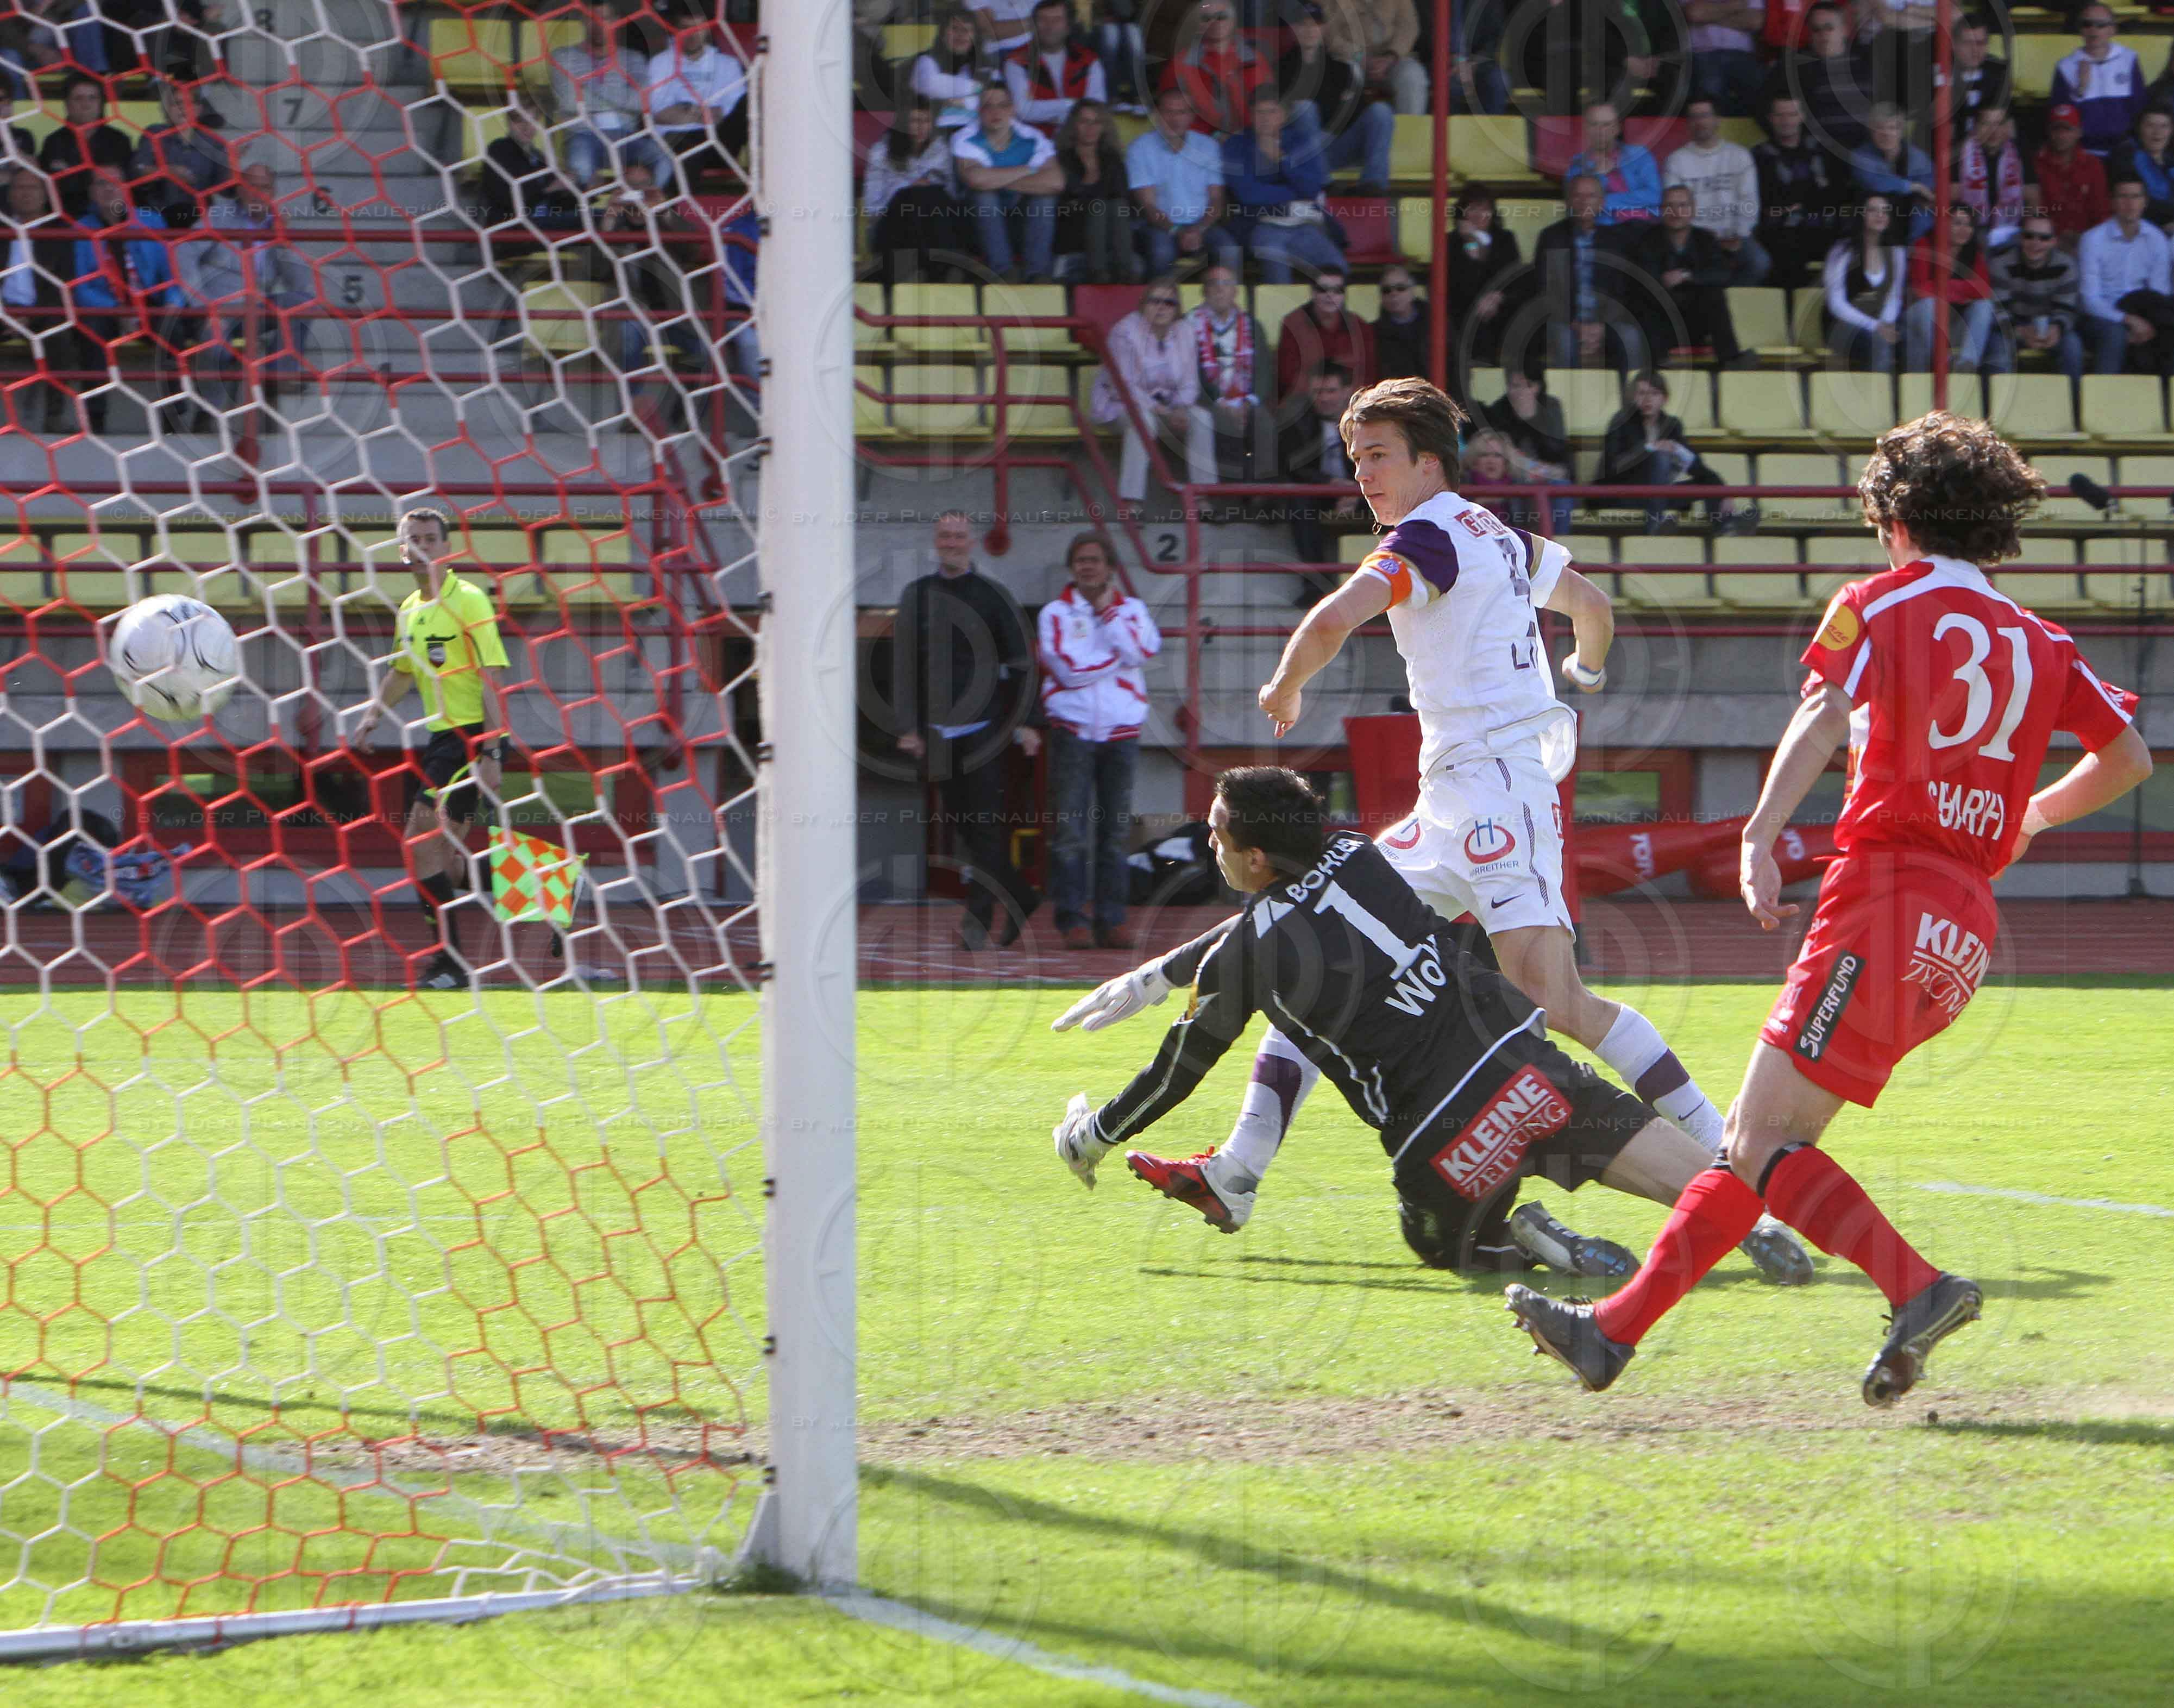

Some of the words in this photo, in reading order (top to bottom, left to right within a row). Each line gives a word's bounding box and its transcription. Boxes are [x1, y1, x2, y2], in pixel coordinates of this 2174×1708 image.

[283, 98, 303, 125] 7
[344, 275, 365, 303] 5
[1158, 532, 1179, 562] 2
[1928, 612, 2033, 762] 31
[1313, 880, 1421, 980] 1
[1800, 955, 1857, 1058] SUPERFUND
[1440, 1073, 1548, 1182] KLEINE
